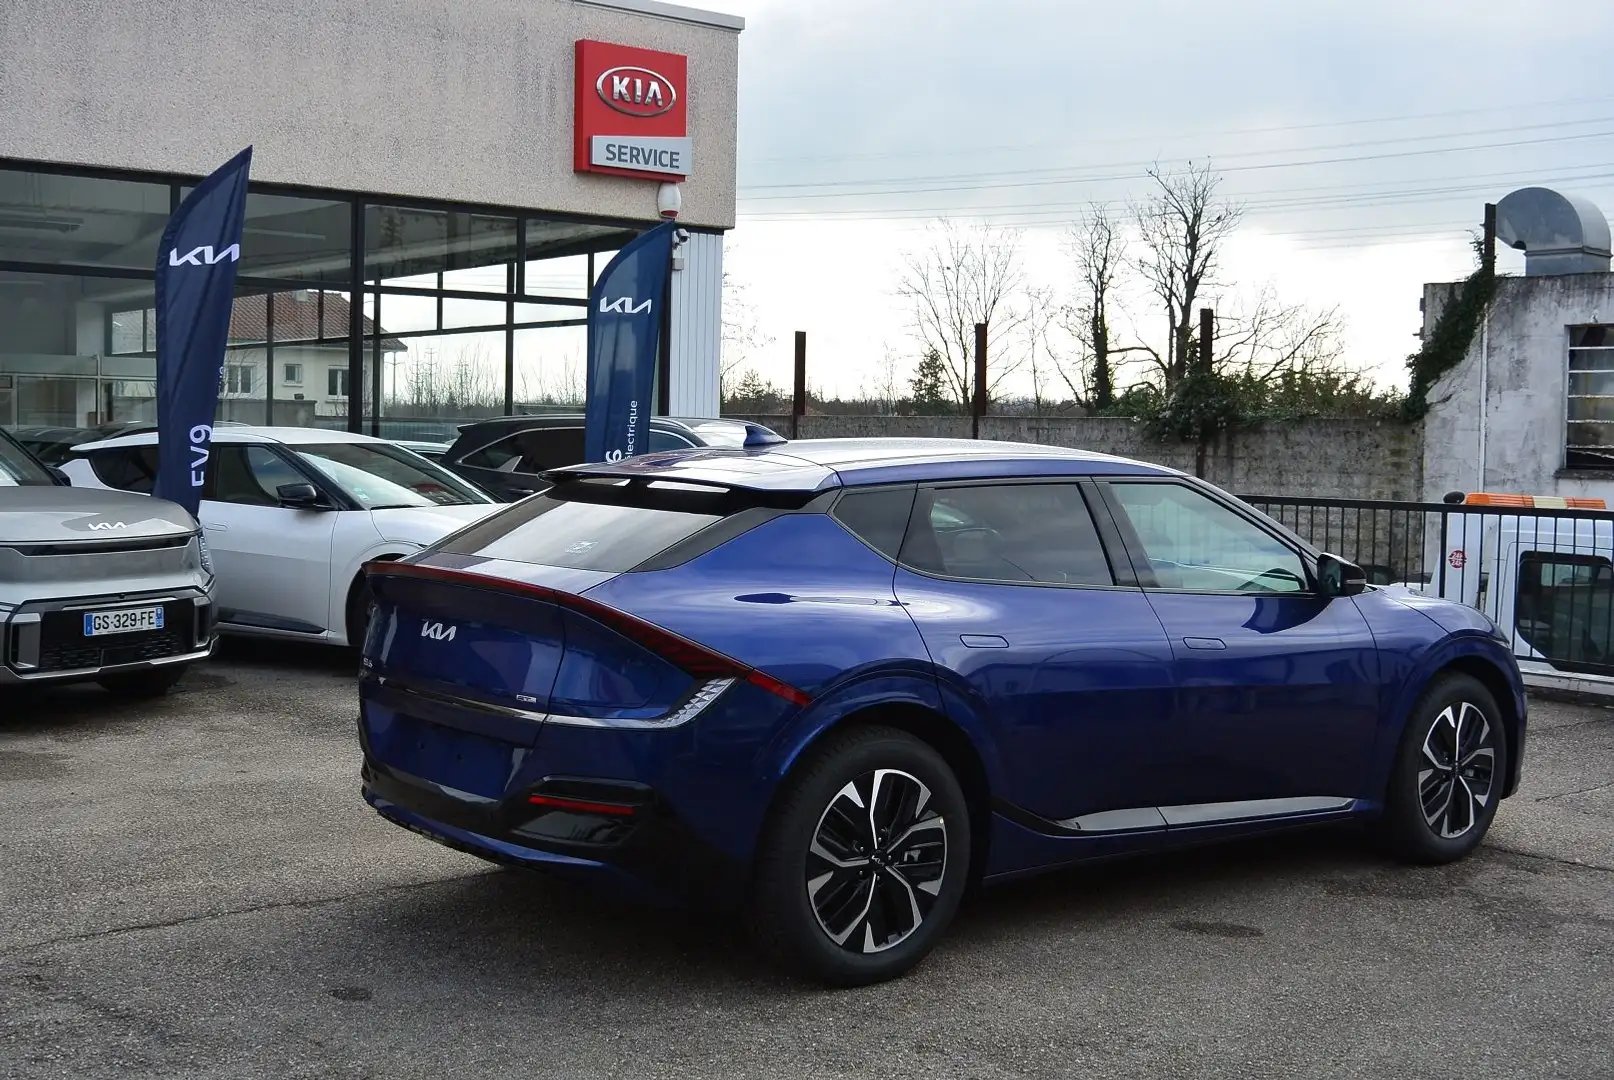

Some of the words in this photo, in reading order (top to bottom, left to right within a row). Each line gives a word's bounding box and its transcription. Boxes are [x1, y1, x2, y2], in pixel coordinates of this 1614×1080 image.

[612, 75, 663, 107] KIA
[605, 143, 680, 169] SERVICE
[93, 610, 155, 631] GS-329-FE
